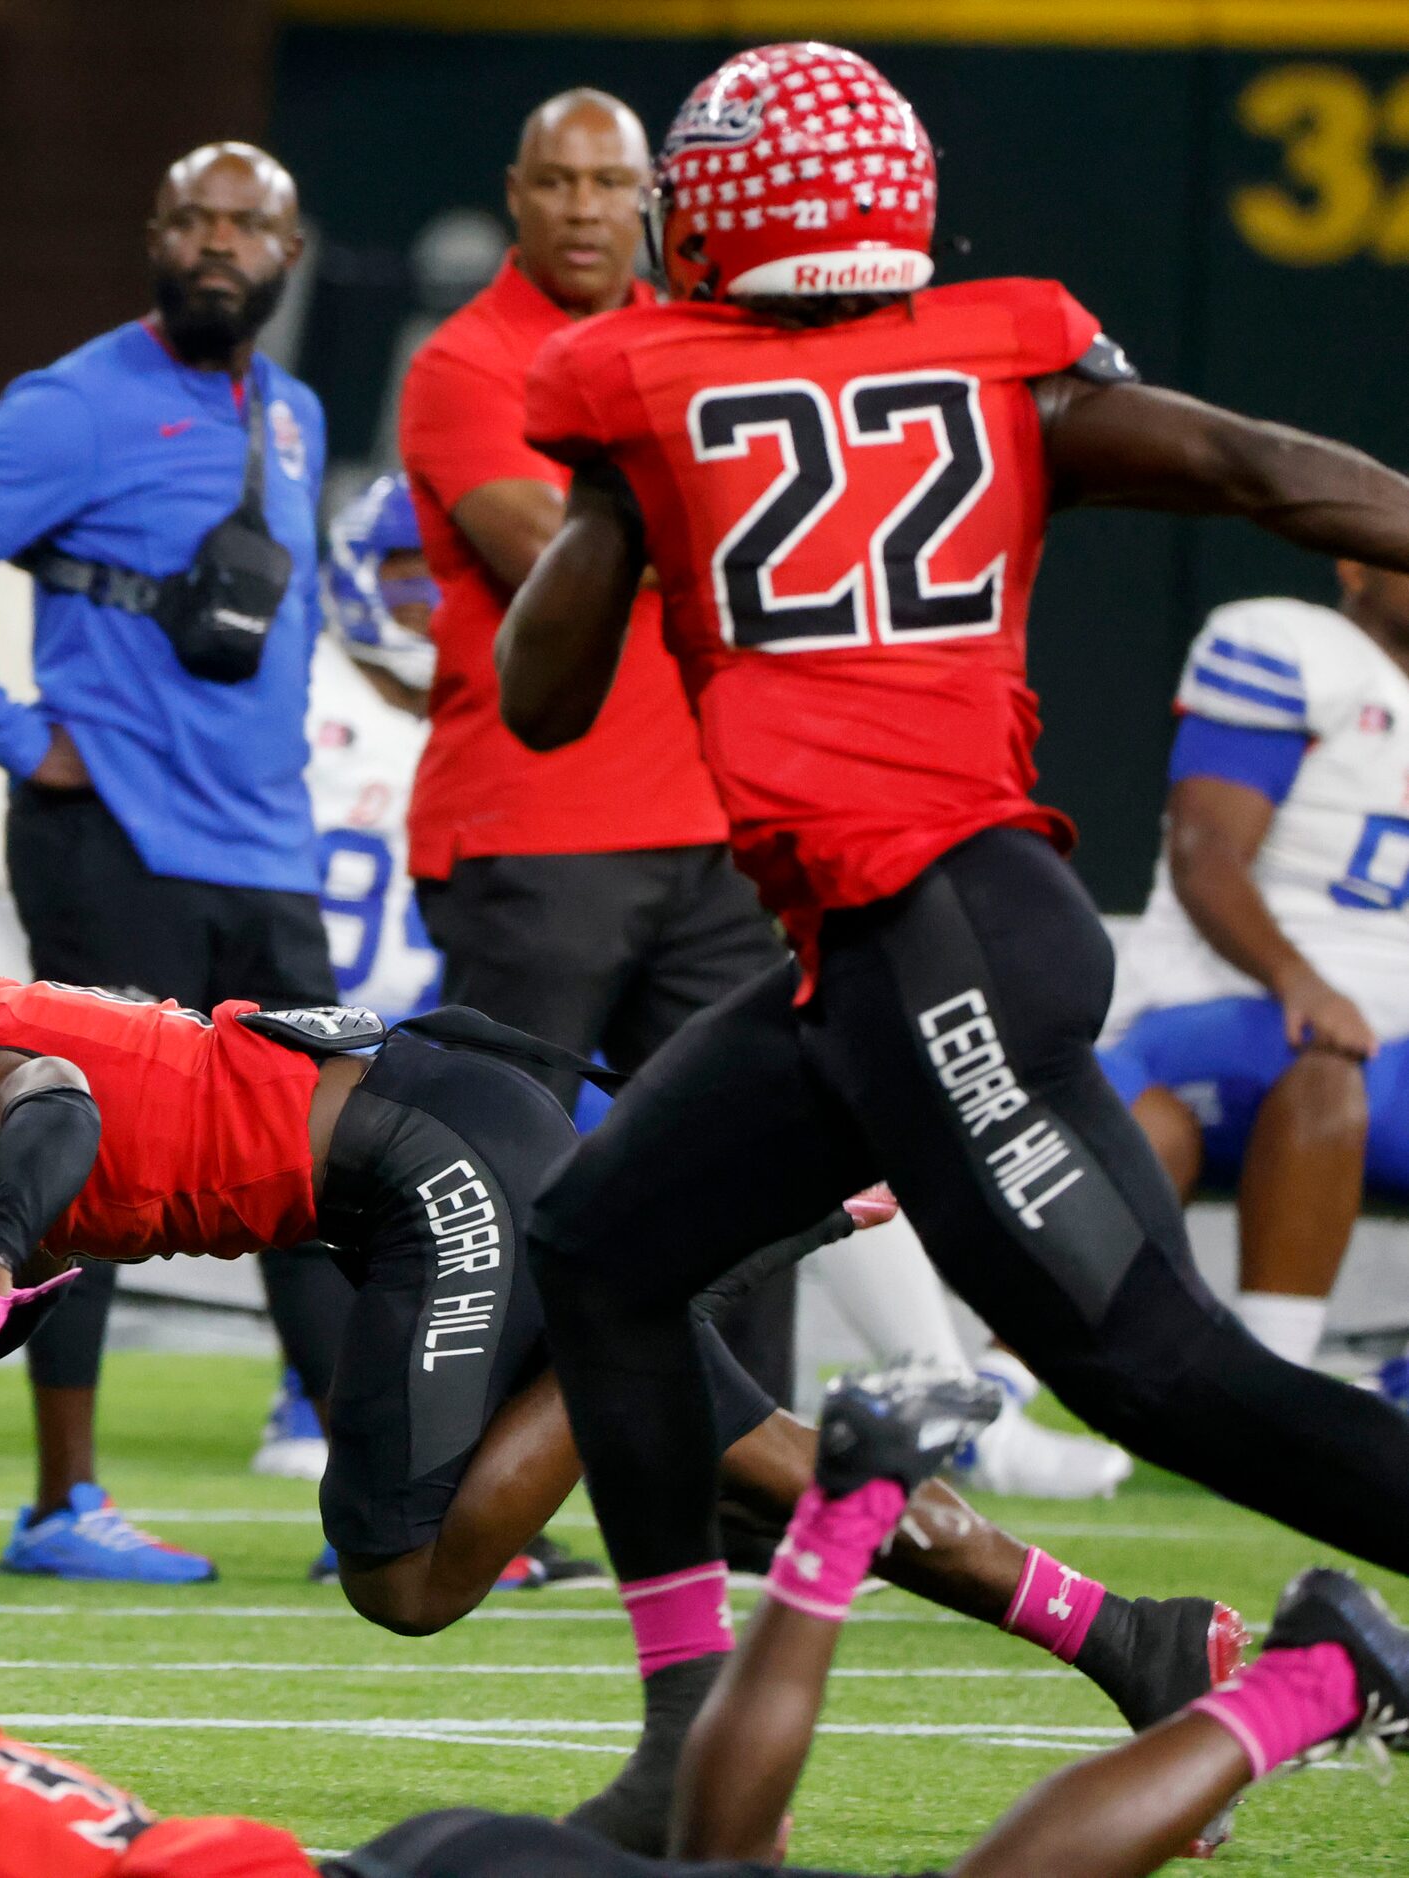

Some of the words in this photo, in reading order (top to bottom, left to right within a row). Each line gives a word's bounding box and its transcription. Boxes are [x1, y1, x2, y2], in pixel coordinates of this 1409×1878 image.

[1228, 63, 1409, 268] 3
[794, 260, 915, 291] Riddell
[686, 369, 1007, 654] 22
[918, 988, 1030, 1137] CEDAR
[986, 1119, 1085, 1229] HILL
[416, 1159, 500, 1280] CEDAR
[423, 1290, 496, 1373] HILL
